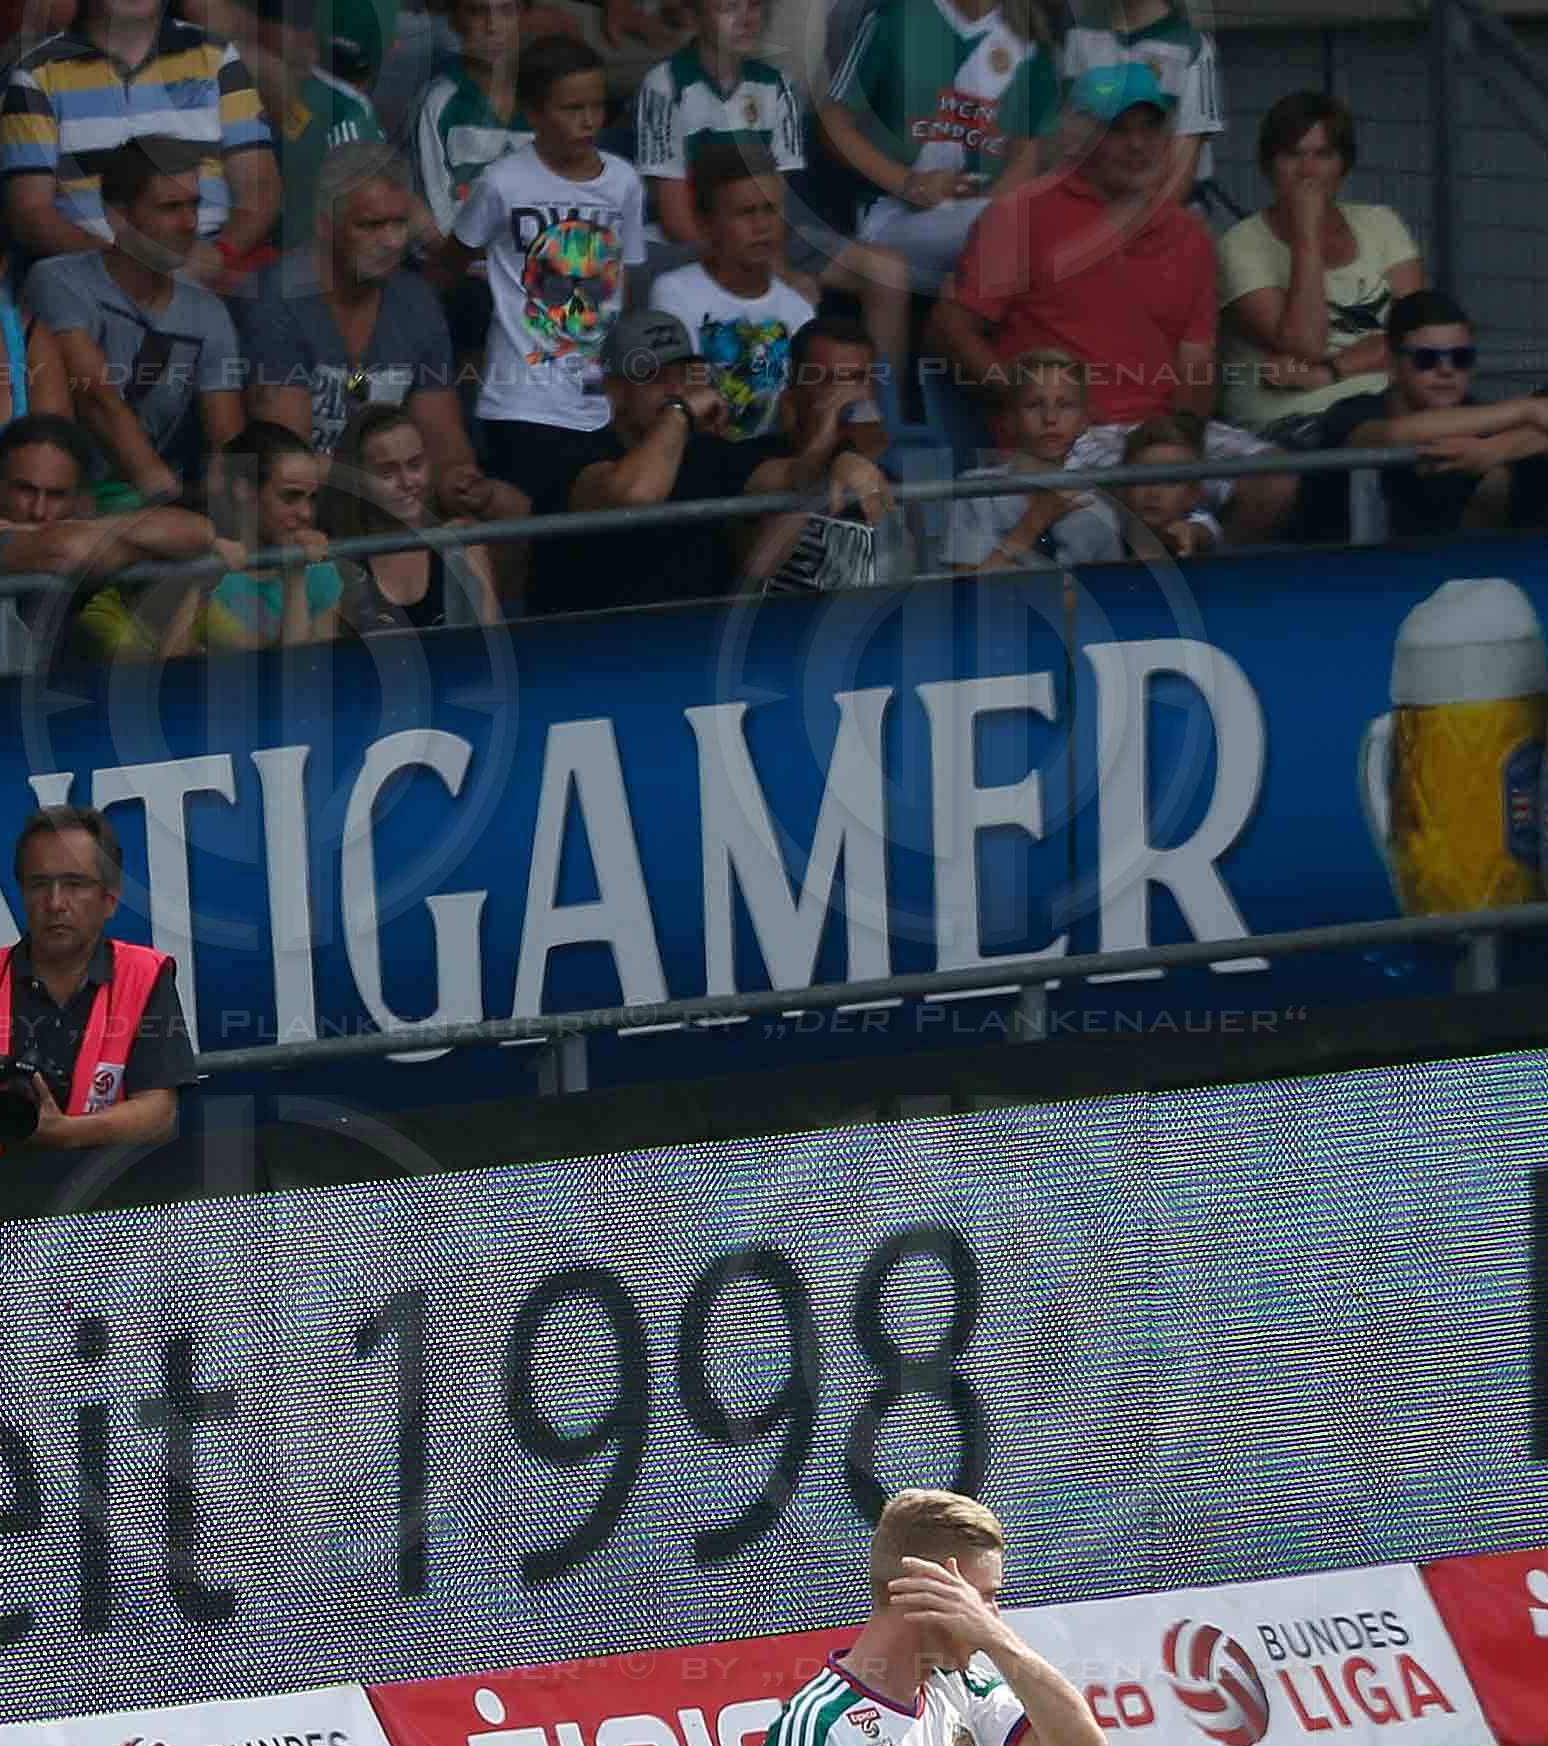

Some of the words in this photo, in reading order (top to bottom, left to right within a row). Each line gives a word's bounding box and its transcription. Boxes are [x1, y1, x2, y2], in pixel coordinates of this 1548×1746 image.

[352, 1226, 990, 1600] 1998
[1256, 1609, 1410, 1662] BUNDES
[1276, 1652, 1459, 1733] LIGA
